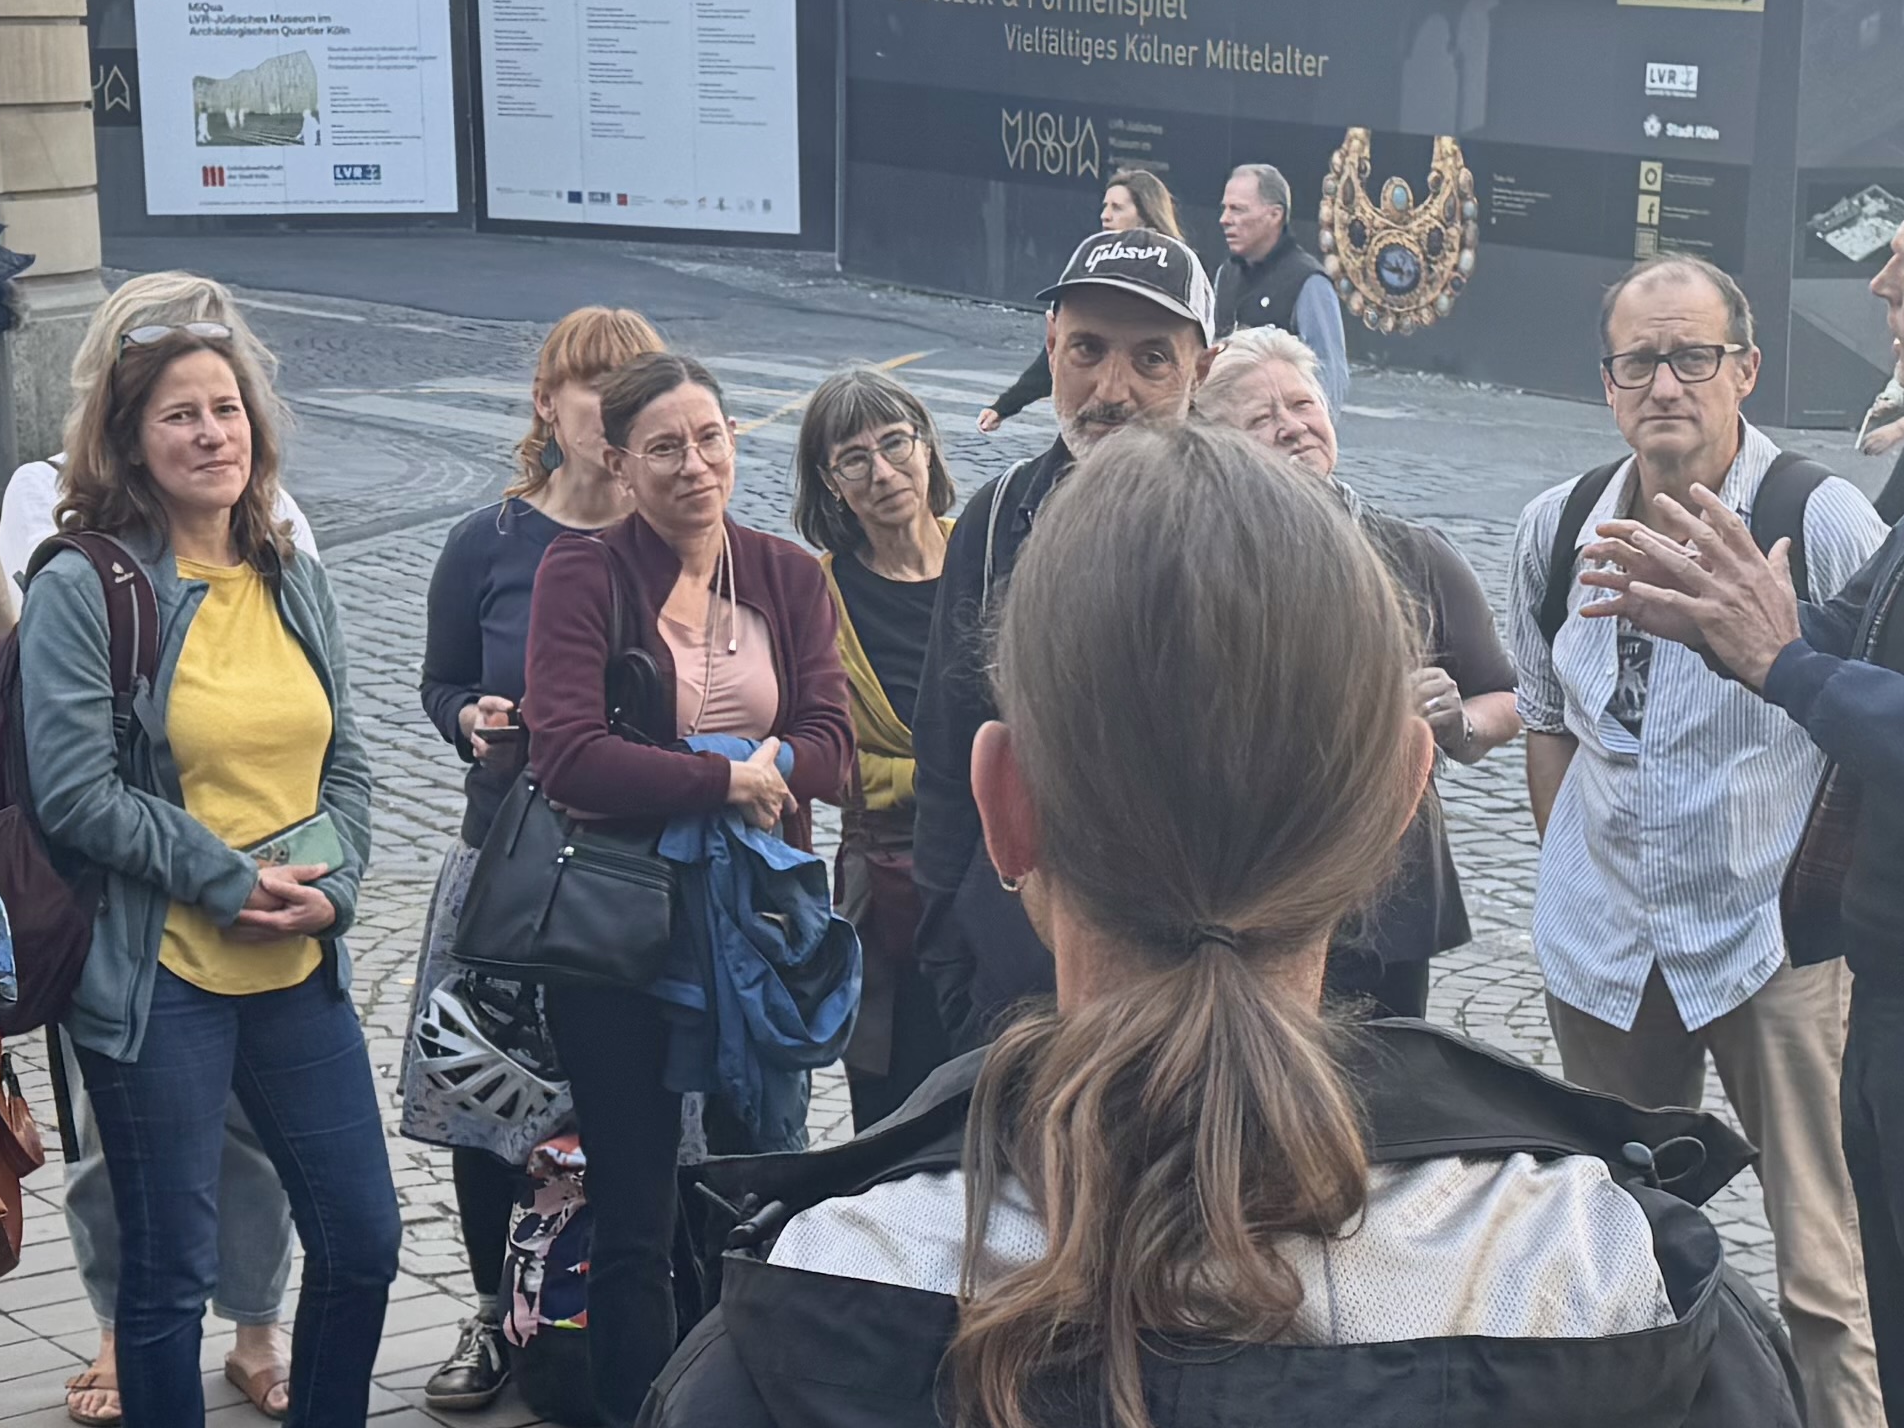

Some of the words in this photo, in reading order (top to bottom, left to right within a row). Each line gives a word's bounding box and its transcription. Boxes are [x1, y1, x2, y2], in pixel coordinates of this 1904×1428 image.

[189, 2, 224, 14] MiQua
[189, 14, 268, 24] LVR-Jüdisches
[270, 14, 315, 24] Museum
[318, 14, 331, 23] im
[189, 25, 279, 37] Archäologischen
[281, 25, 324, 37] Quartier
[327, 25, 351, 36] Köln
[1005, 23, 1118, 66] Vielfältiges
[1125, 34, 1199, 67] Kölner
[1206, 38, 1329, 78] Mittelalter
[1649, 68, 1678, 85] LVR
[1666, 122, 1694, 138] Stadt
[335, 166, 363, 180] LVR
[1085, 241, 1168, 272] Gibson
